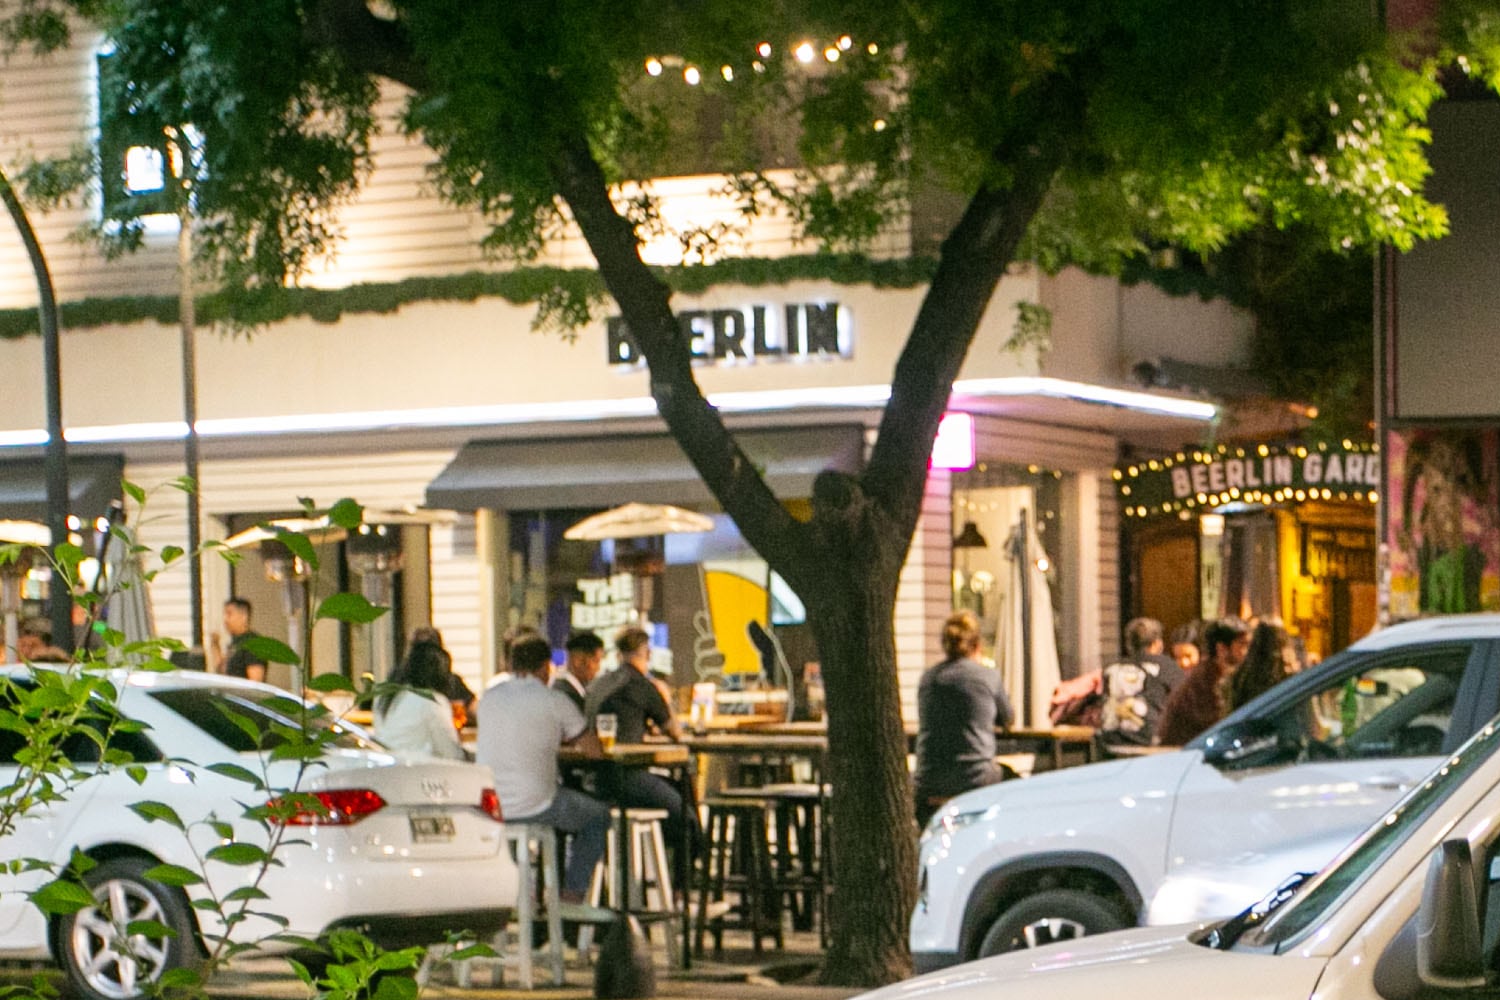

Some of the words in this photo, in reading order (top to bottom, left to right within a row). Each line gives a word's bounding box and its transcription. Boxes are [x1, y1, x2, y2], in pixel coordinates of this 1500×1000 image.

[607, 302, 841, 365] BERLIN
[1171, 456, 1293, 498] BEERLIN
[576, 572, 634, 604] THE
